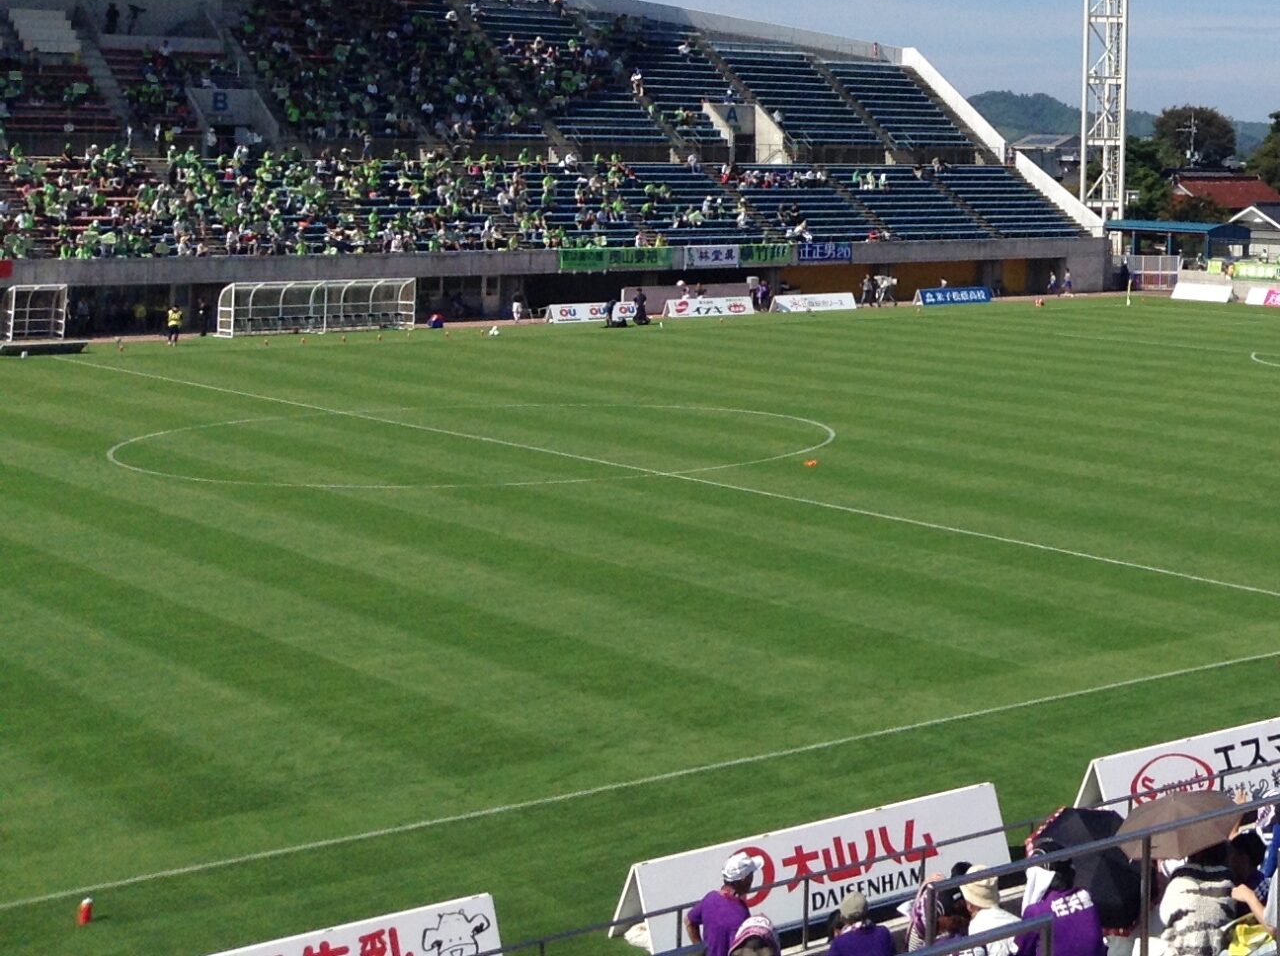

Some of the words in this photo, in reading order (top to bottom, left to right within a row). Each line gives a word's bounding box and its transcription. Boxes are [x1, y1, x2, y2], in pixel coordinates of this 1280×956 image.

[213, 91, 229, 111] B
[782, 819, 939, 893] 大山ハム
